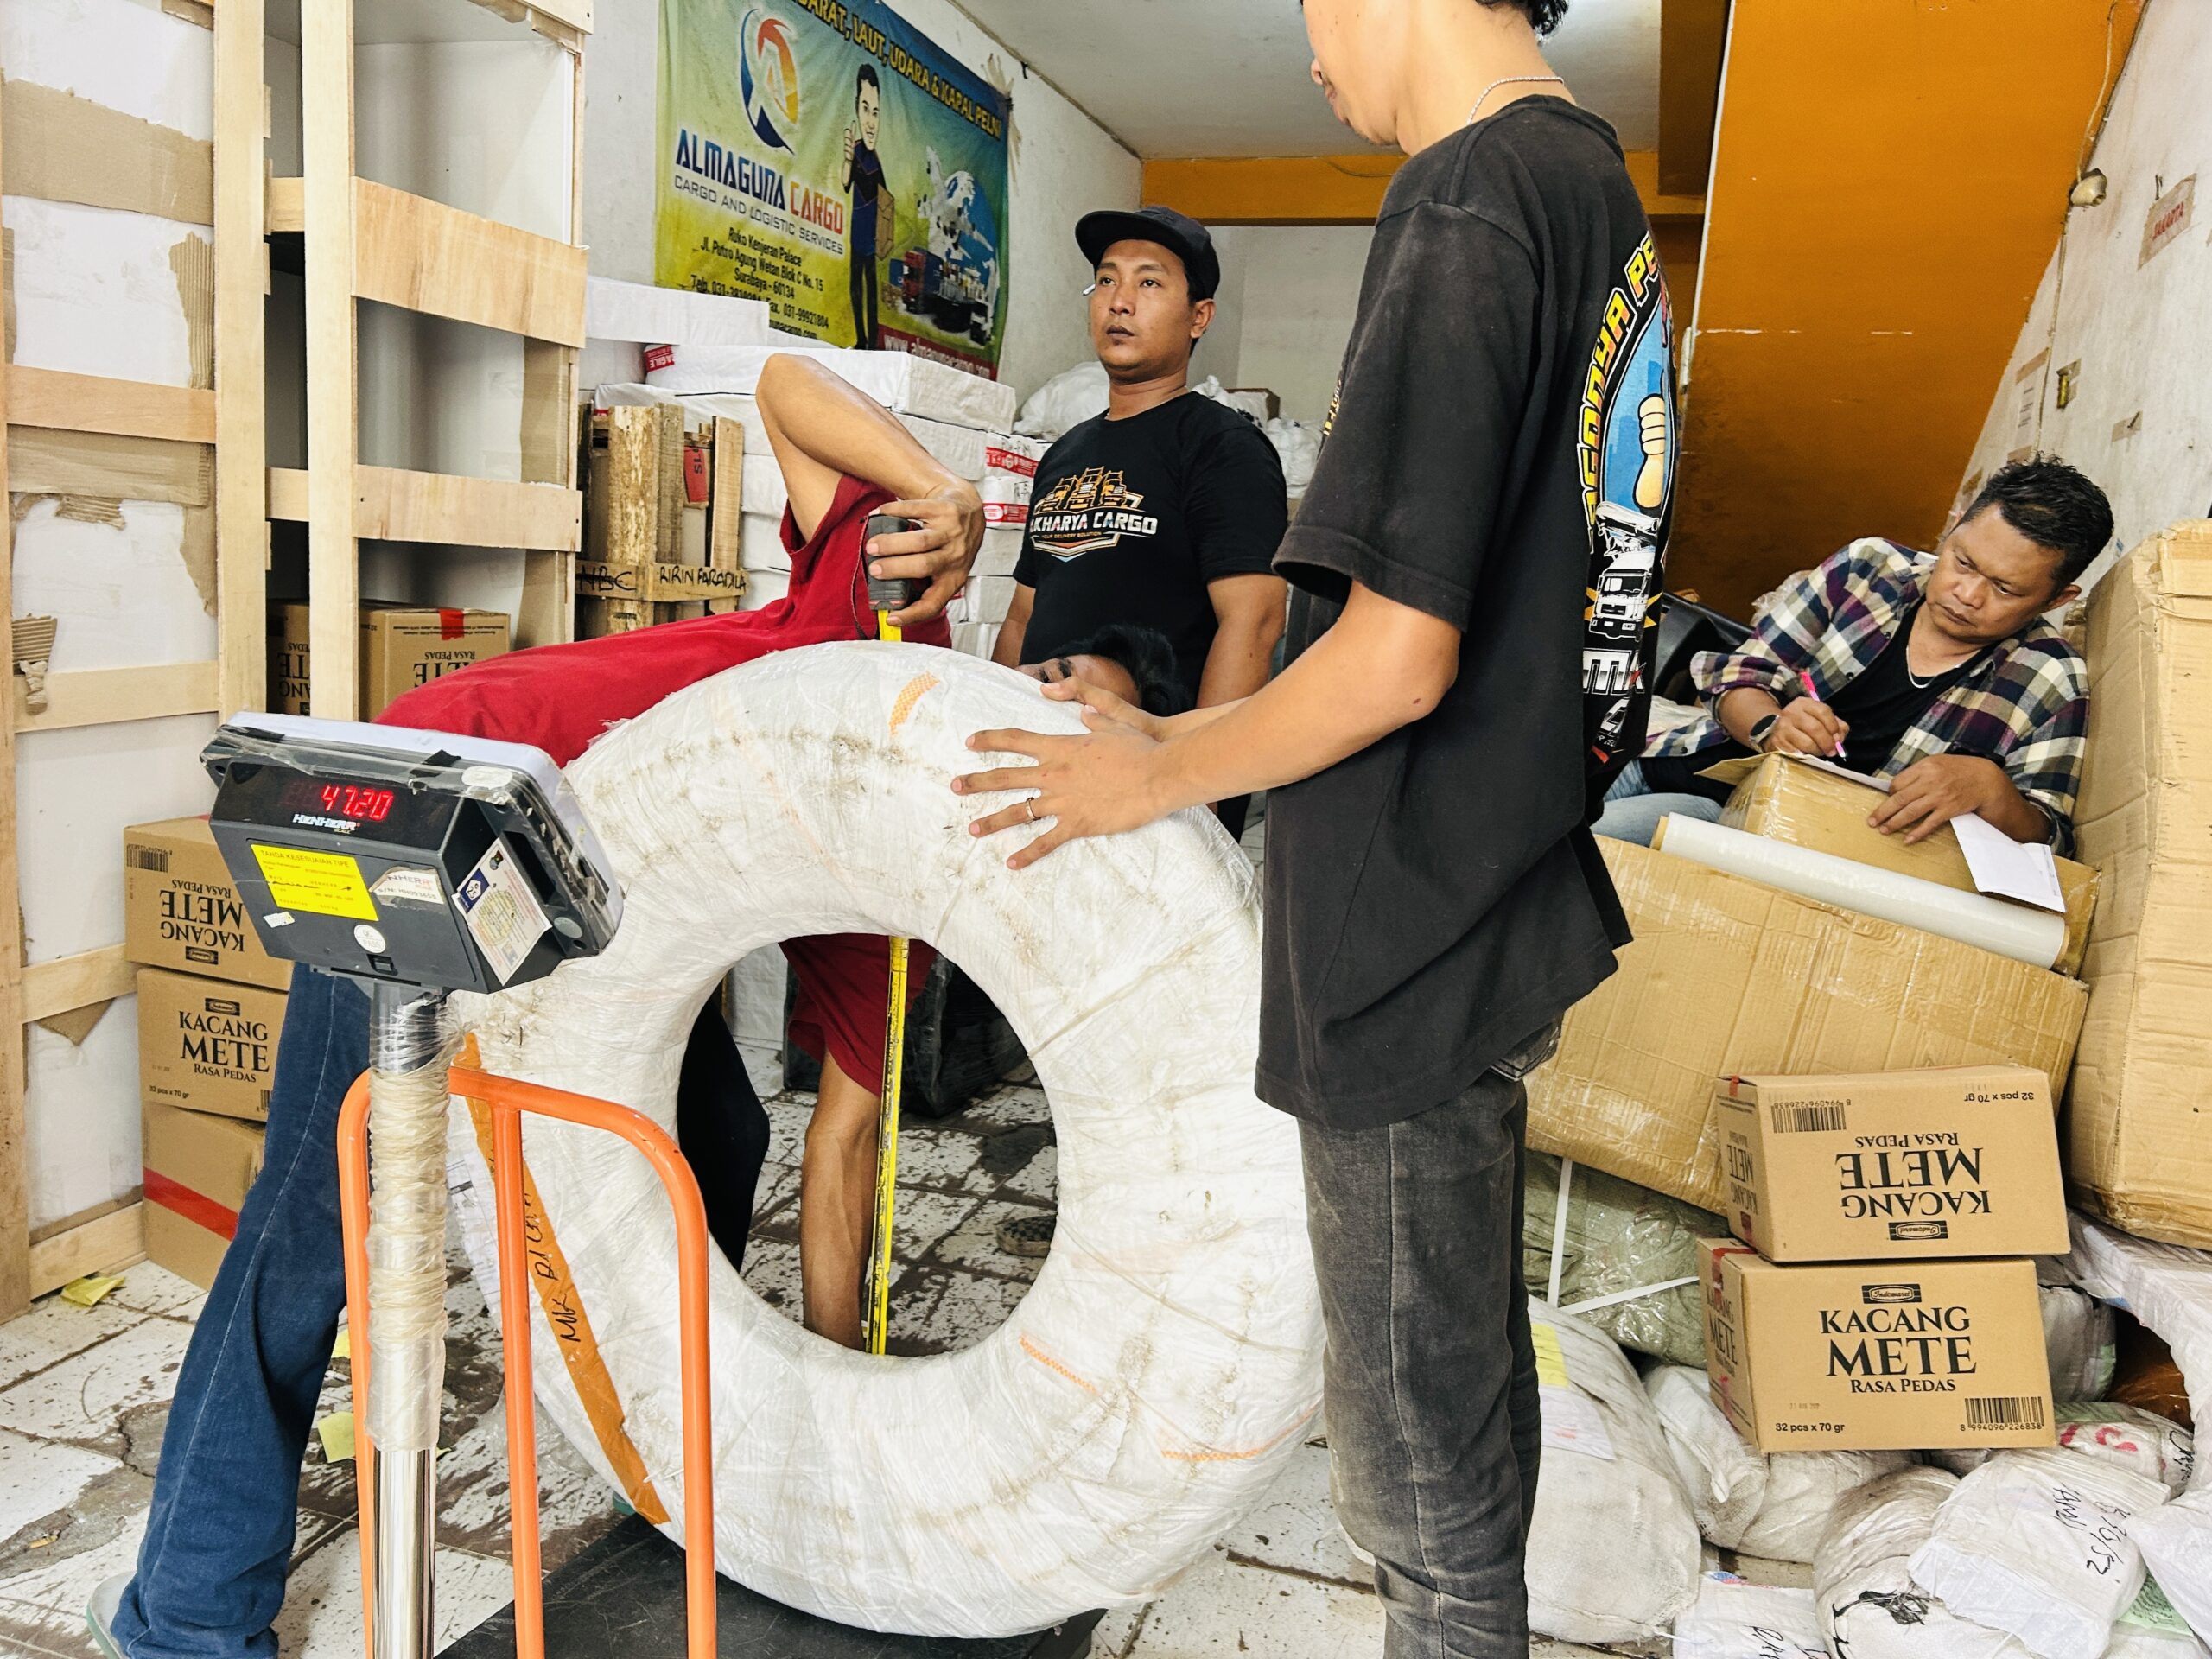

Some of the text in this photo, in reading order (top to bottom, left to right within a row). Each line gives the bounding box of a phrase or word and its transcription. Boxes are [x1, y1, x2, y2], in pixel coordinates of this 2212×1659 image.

[853, 13, 887, 67] LAUT,
[888, 43, 930, 92] UDARA
[931, 73, 940, 97] &
[941, 76, 975, 122] KAPAL
[975, 105, 1002, 140] PELNI
[675, 128, 844, 235] ALMAGUNA CARGO
[674, 175, 844, 255] CARGO AND LOGISTIC SERVICES
[734, 249, 757, 271] Agung
[759, 257, 780, 277] Wetan
[781, 265, 795, 282] Blok
[797, 271, 802, 284] C
[815, 278, 823, 291] 15
[779, 247, 802, 267] Palace
[734, 267, 767, 292] Surabaya
[1092, 512, 1158, 535] CARGO
[658, 564, 695, 587] RIRIN
[424, 651, 475, 659] RASA PEDAS
[171, 879, 232, 899] RASA PEDAS
[159, 889, 244, 930] METE
[160, 920, 245, 952] KACANG
[179, 1010, 269, 1041] KACANG
[181, 1033, 270, 1072] METE
[194, 1063, 257, 1083] RASA PEDAS
[1963, 1093, 1976, 1103] gr
[1976, 1093, 1990, 1103] 70
[2000, 1092, 2019, 1103] pcs
[2021, 1091, 2035, 1101] 32
[1855, 1132, 1959, 1148] RASA PEDAS
[1727, 1144, 1755, 1187] METE
[1835, 1147, 1983, 1191] METE
[1840, 1190, 1991, 1218] KACANG
[1818, 1306, 1971, 1333] KACANG
[1708, 1312, 1738, 1365] METE
[1825, 1336, 1978, 1377] METE
[1850, 1378, 1956, 1394] RASA PEDAS
[1776, 1422, 1788, 1432] 32
[1790, 1424, 1809, 1433] pcs
[1819, 1422, 1831, 1431] 70
[1834, 1423, 1845, 1433] gr
